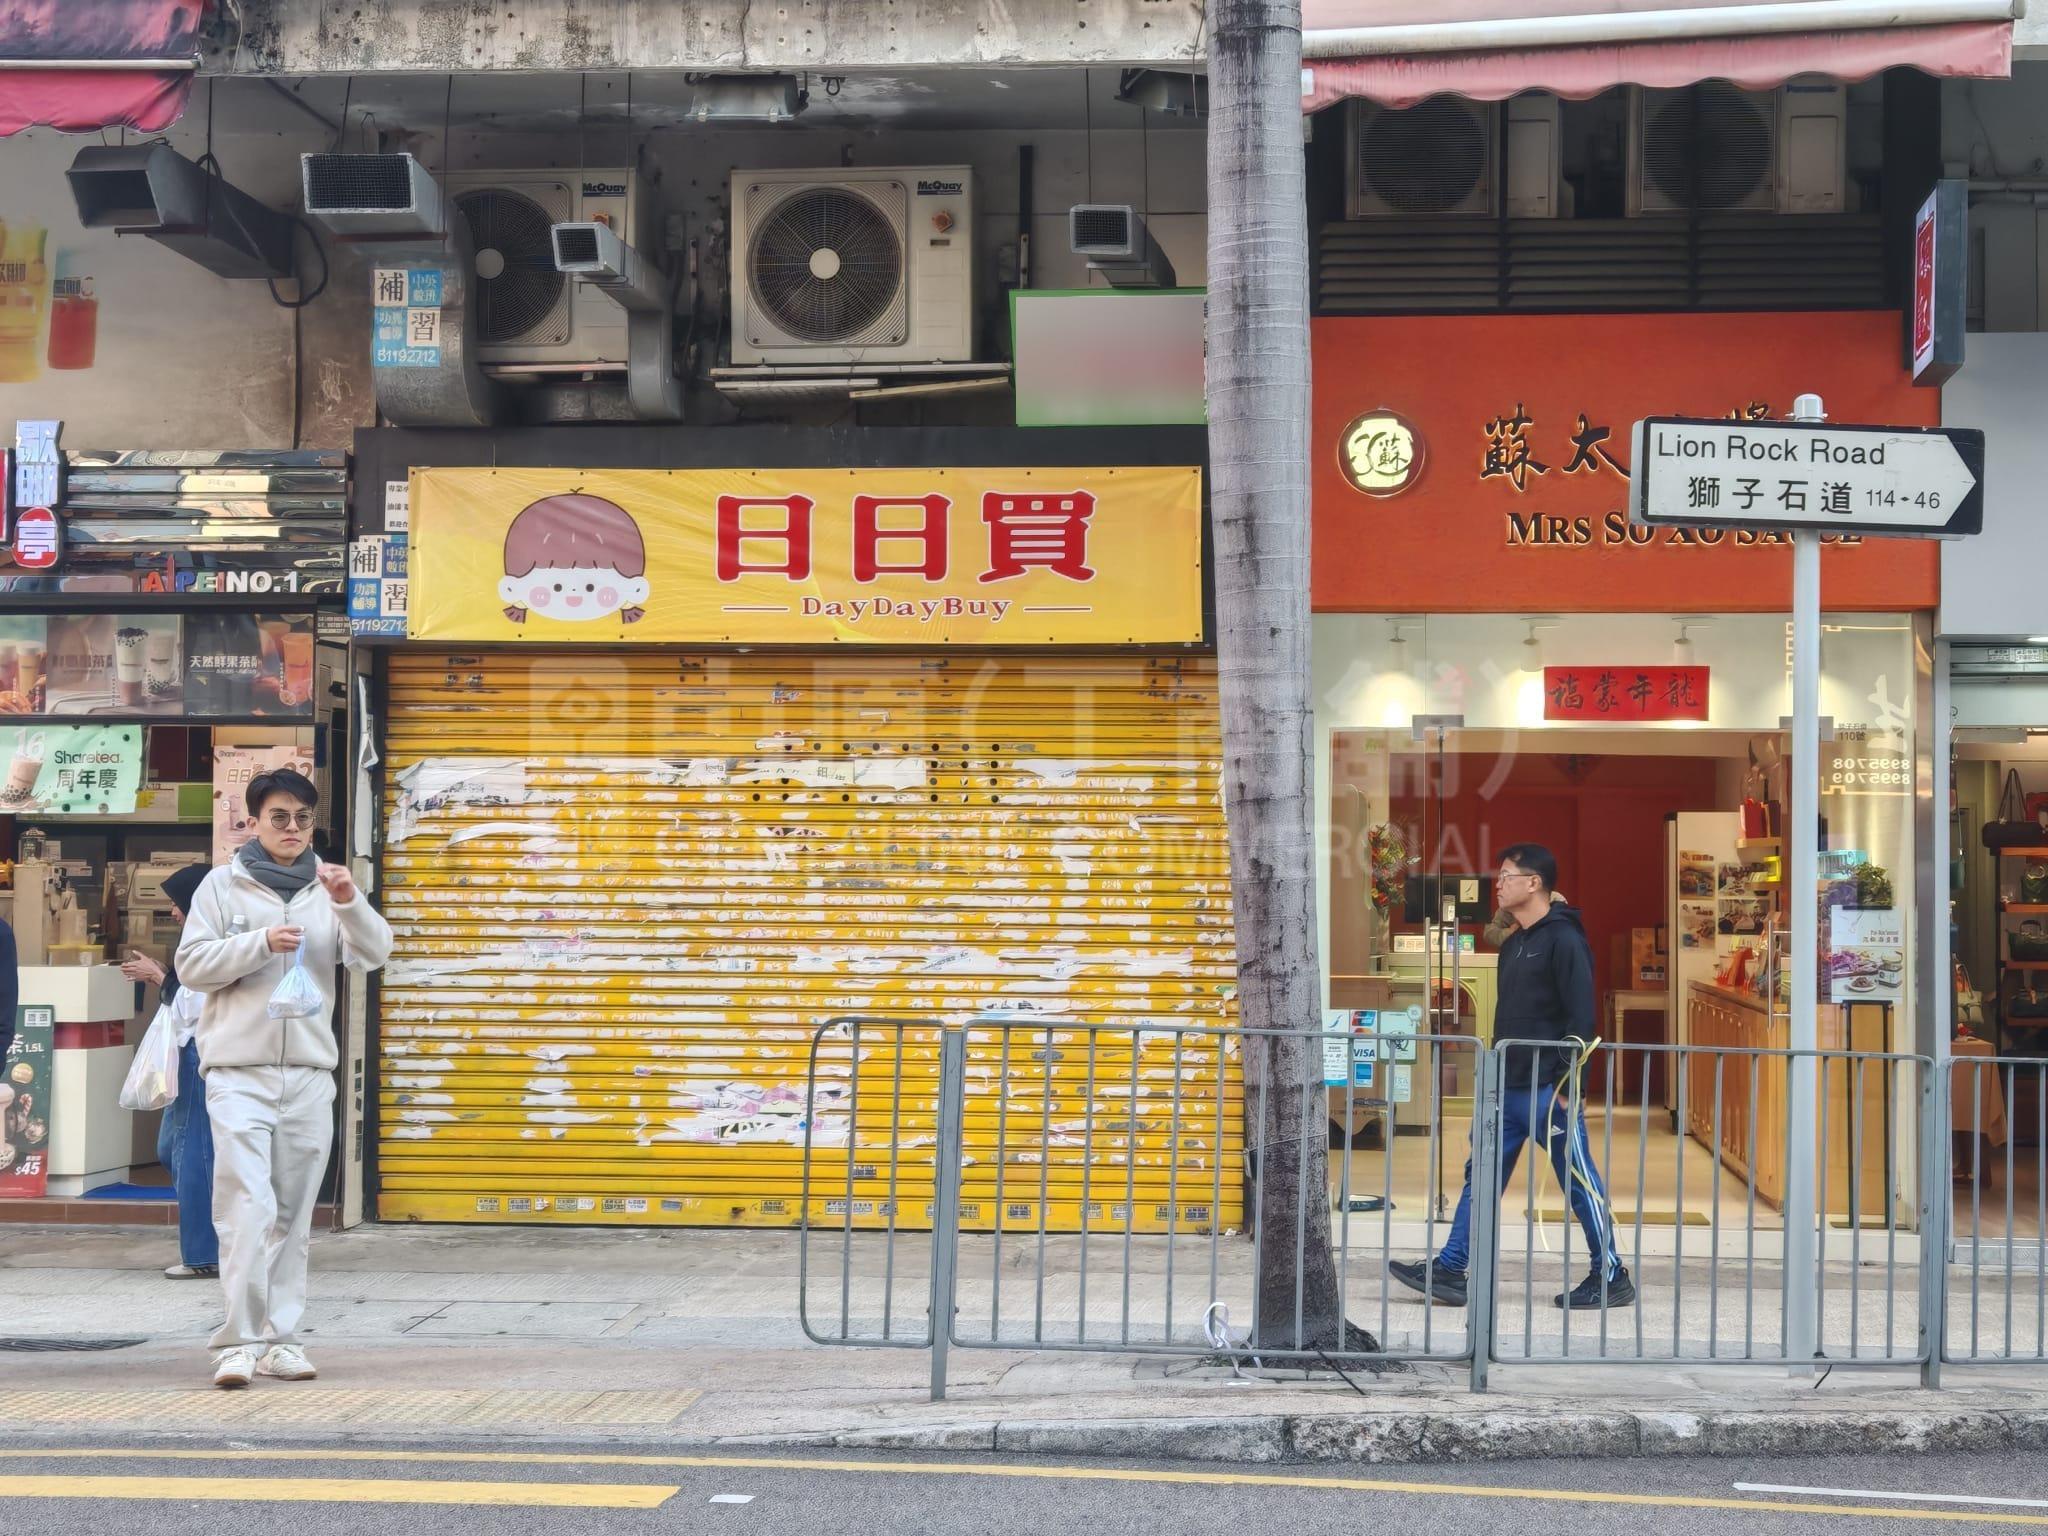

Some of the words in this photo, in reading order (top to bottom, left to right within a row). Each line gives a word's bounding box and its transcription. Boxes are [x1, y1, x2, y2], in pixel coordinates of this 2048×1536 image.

[583, 182, 625, 193] McQuay
[918, 180, 961, 191] McQuay
[378, 271, 404, 302] 補
[411, 312, 435, 341] 習
[1659, 432, 1716, 458] Lion
[1727, 435, 1798, 462] Rock
[1810, 439, 1885, 465] Road
[1687, 475, 1853, 515] 獅子石道
[1866, 489, 1896, 508] 114
[1914, 491, 1941, 510] 46
[717, 491, 1096, 583] 日日買
[351, 545, 378, 573] 補
[226, 571, 297, 593] NO.1
[385, 584, 408, 611] 習
[801, 597, 1011, 621] DayDayBuy
[351, 618, 407, 632] 51192712
[54, 750, 120, 764] Sharetea
[57, 769, 118, 789] 周年慶
[25, 1043, 45, 1053] 1.5L
[1353, 1048, 1376, 1058] VISA
[15, 1161, 41, 1175] $45
